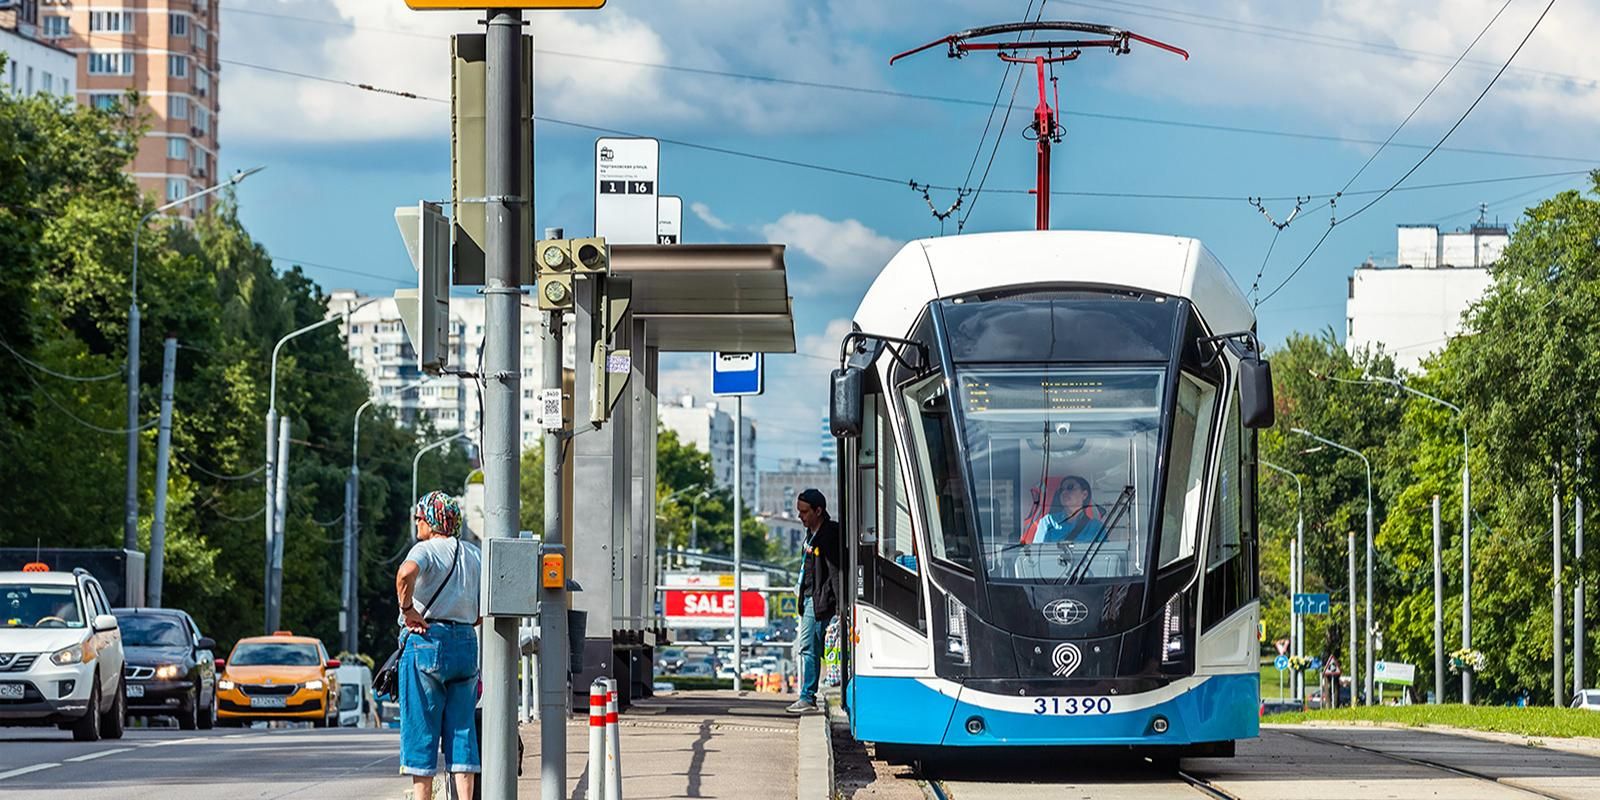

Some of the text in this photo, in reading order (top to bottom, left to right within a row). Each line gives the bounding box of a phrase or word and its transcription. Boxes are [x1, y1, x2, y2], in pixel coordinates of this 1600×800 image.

[610, 182, 647, 193] 1 16
[660, 236, 671, 244] 16
[684, 594, 735, 614] SALE
[1034, 697, 1111, 714] 31390
